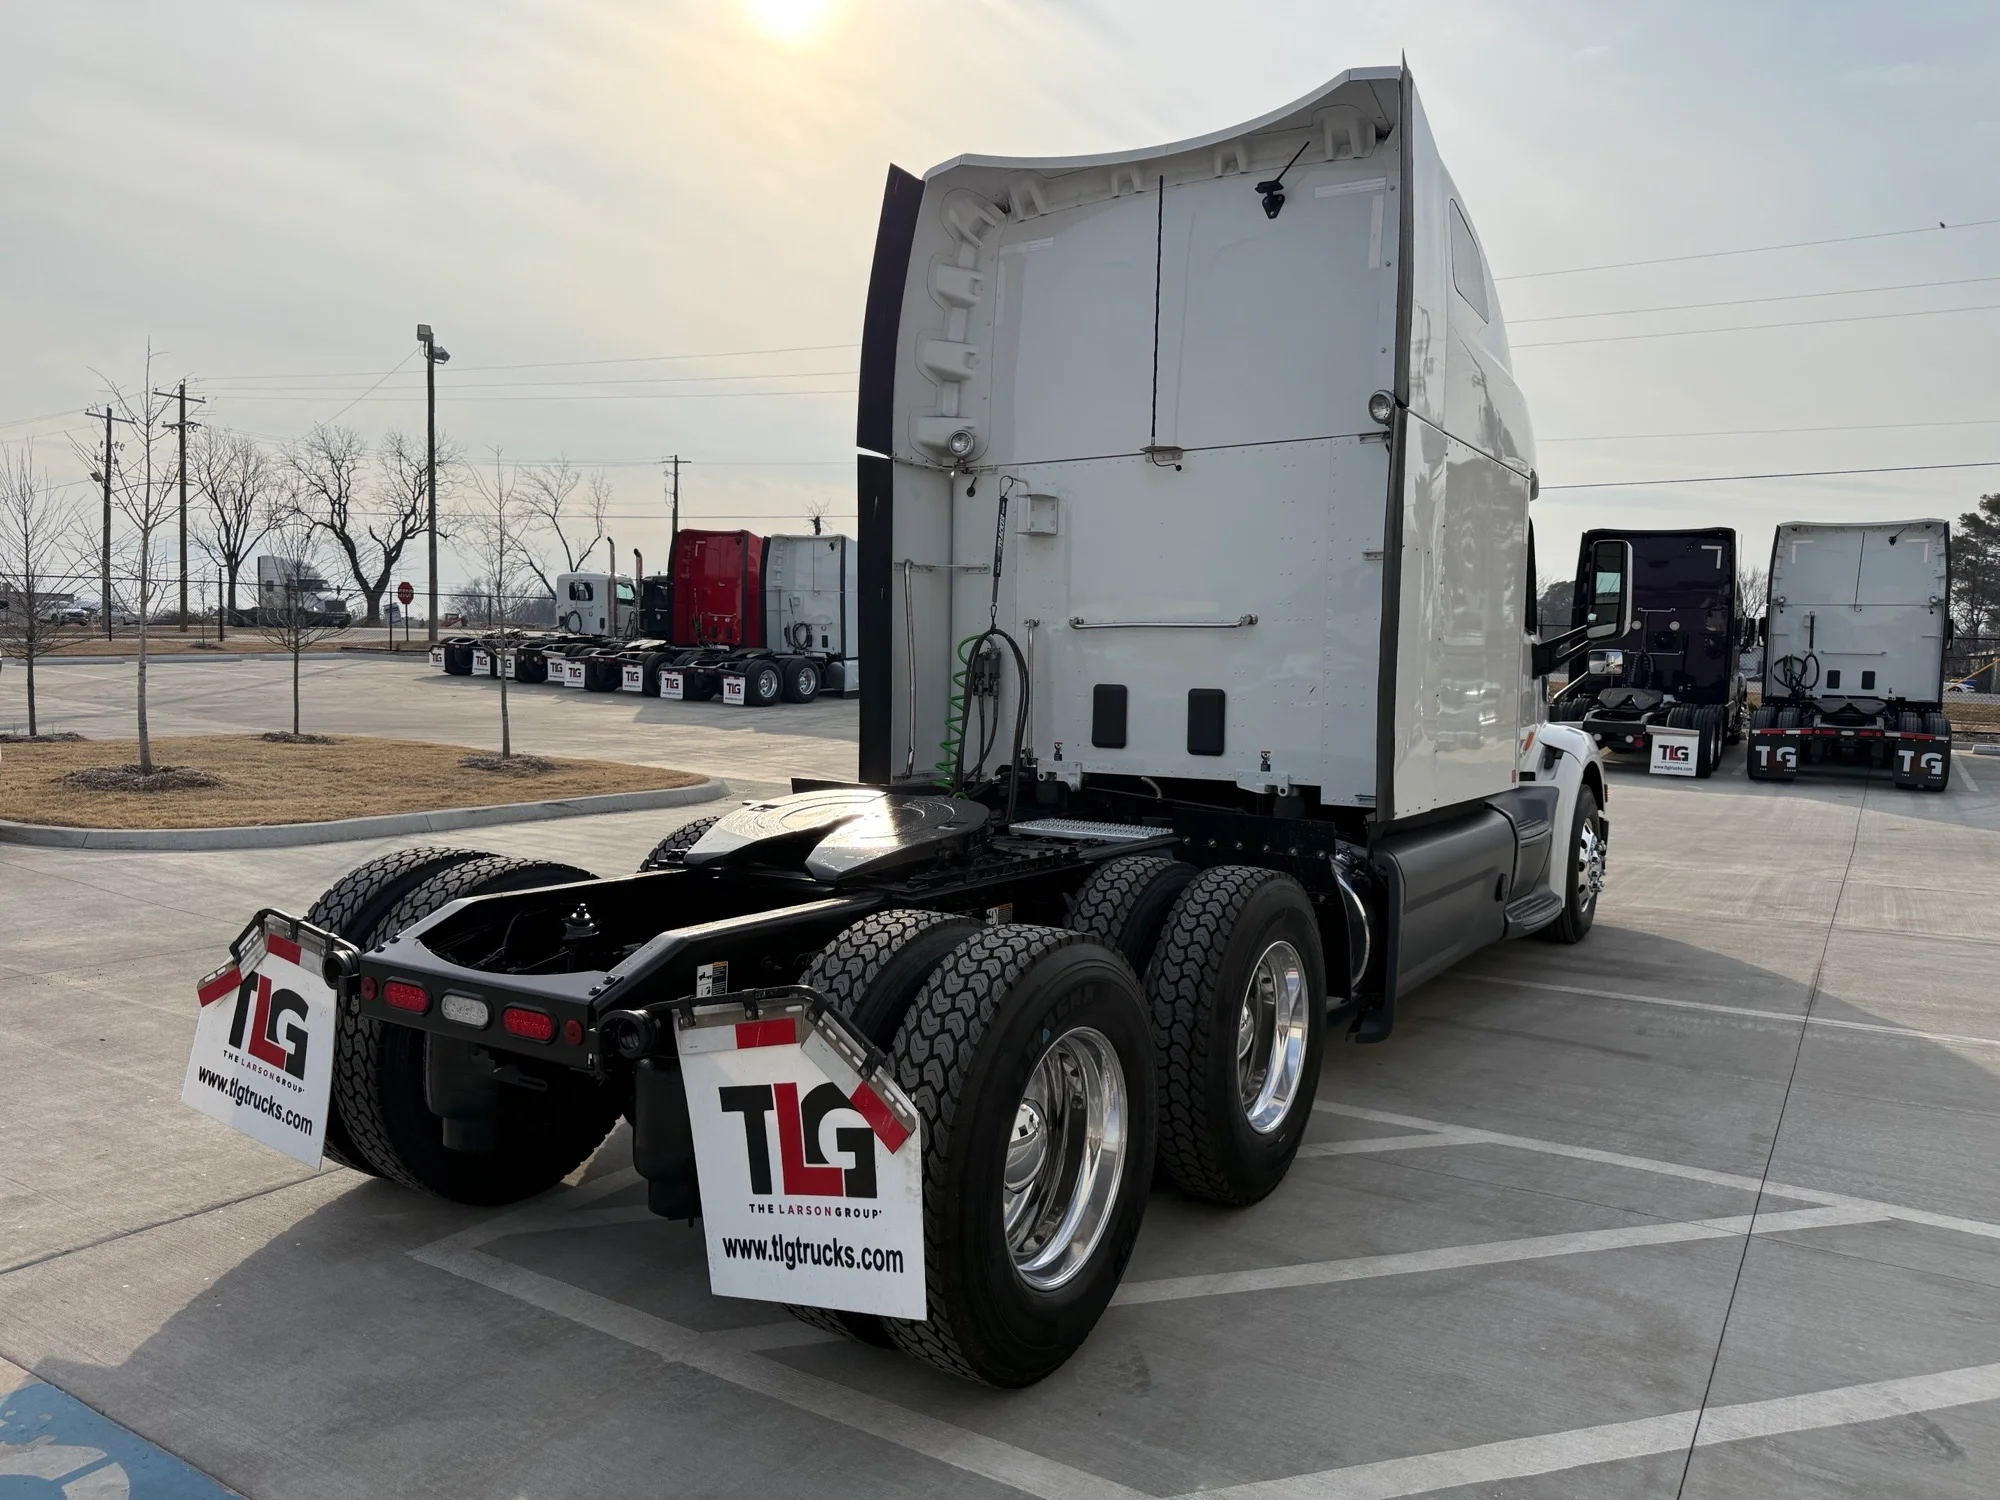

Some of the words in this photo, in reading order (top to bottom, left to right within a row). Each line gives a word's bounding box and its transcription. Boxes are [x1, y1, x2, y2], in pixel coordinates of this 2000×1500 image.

[550, 662, 563, 673] TLG
[568, 667, 581, 678] TLG
[625, 671, 639, 682] TLG
[665, 677, 679, 689] TLG
[726, 682, 741, 694] TLG
[1658, 745, 1689, 761] TLG
[228, 970, 309, 1081] TLG
[223, 1049, 239, 1063] THE
[241, 1057, 275, 1081] LARSON
[275, 1076, 303, 1094] GROUP
[198, 1065, 314, 1136] www.tlgtrucks.com
[718, 1081, 878, 1199] TLG
[749, 1203, 774, 1214] THE
[779, 1204, 832, 1217] LARSON
[835, 1206, 879, 1219] GROUP
[722, 1233, 905, 1274] www.tlgtrucks.com
